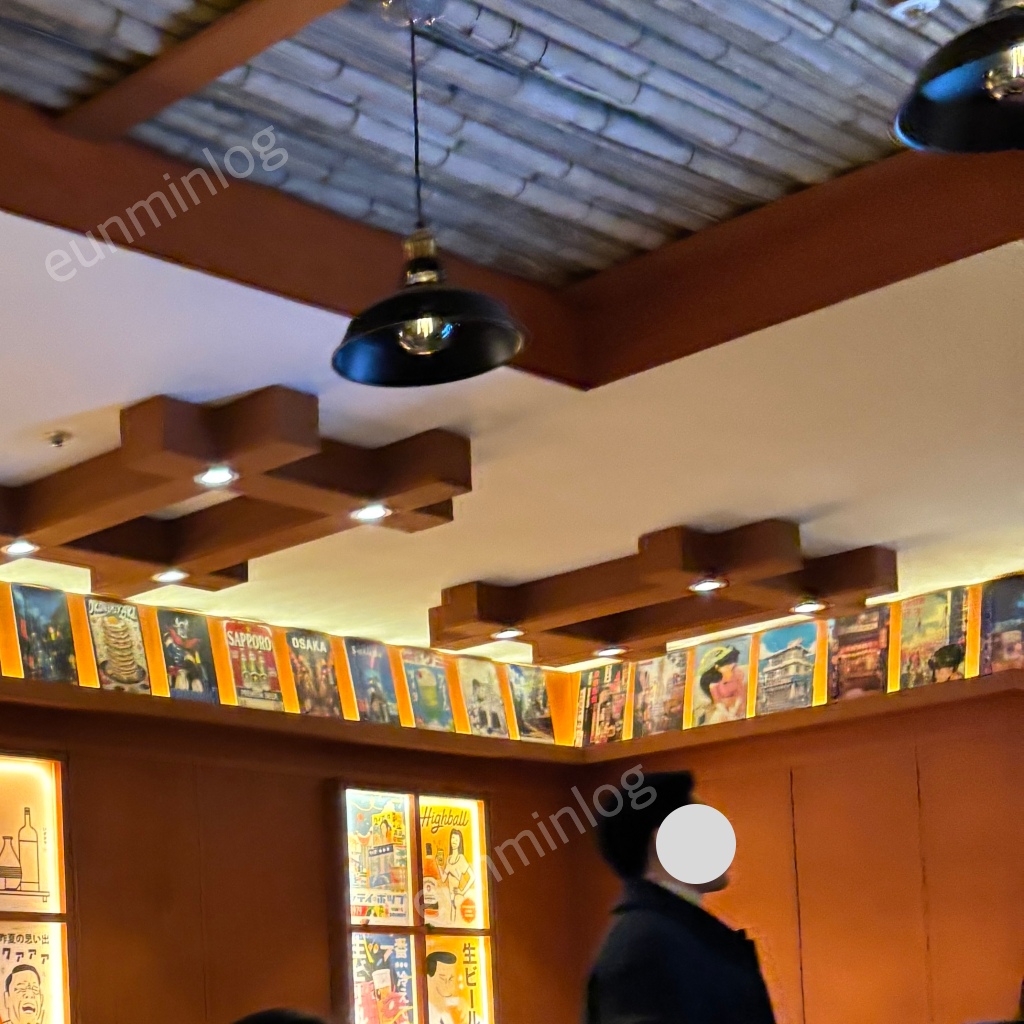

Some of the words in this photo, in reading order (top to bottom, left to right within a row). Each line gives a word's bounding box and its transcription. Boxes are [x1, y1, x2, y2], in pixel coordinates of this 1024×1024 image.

[227, 631, 272, 652] SAPPORO
[291, 637, 328, 653] OSAKA
[419, 806, 469, 834] Highball
